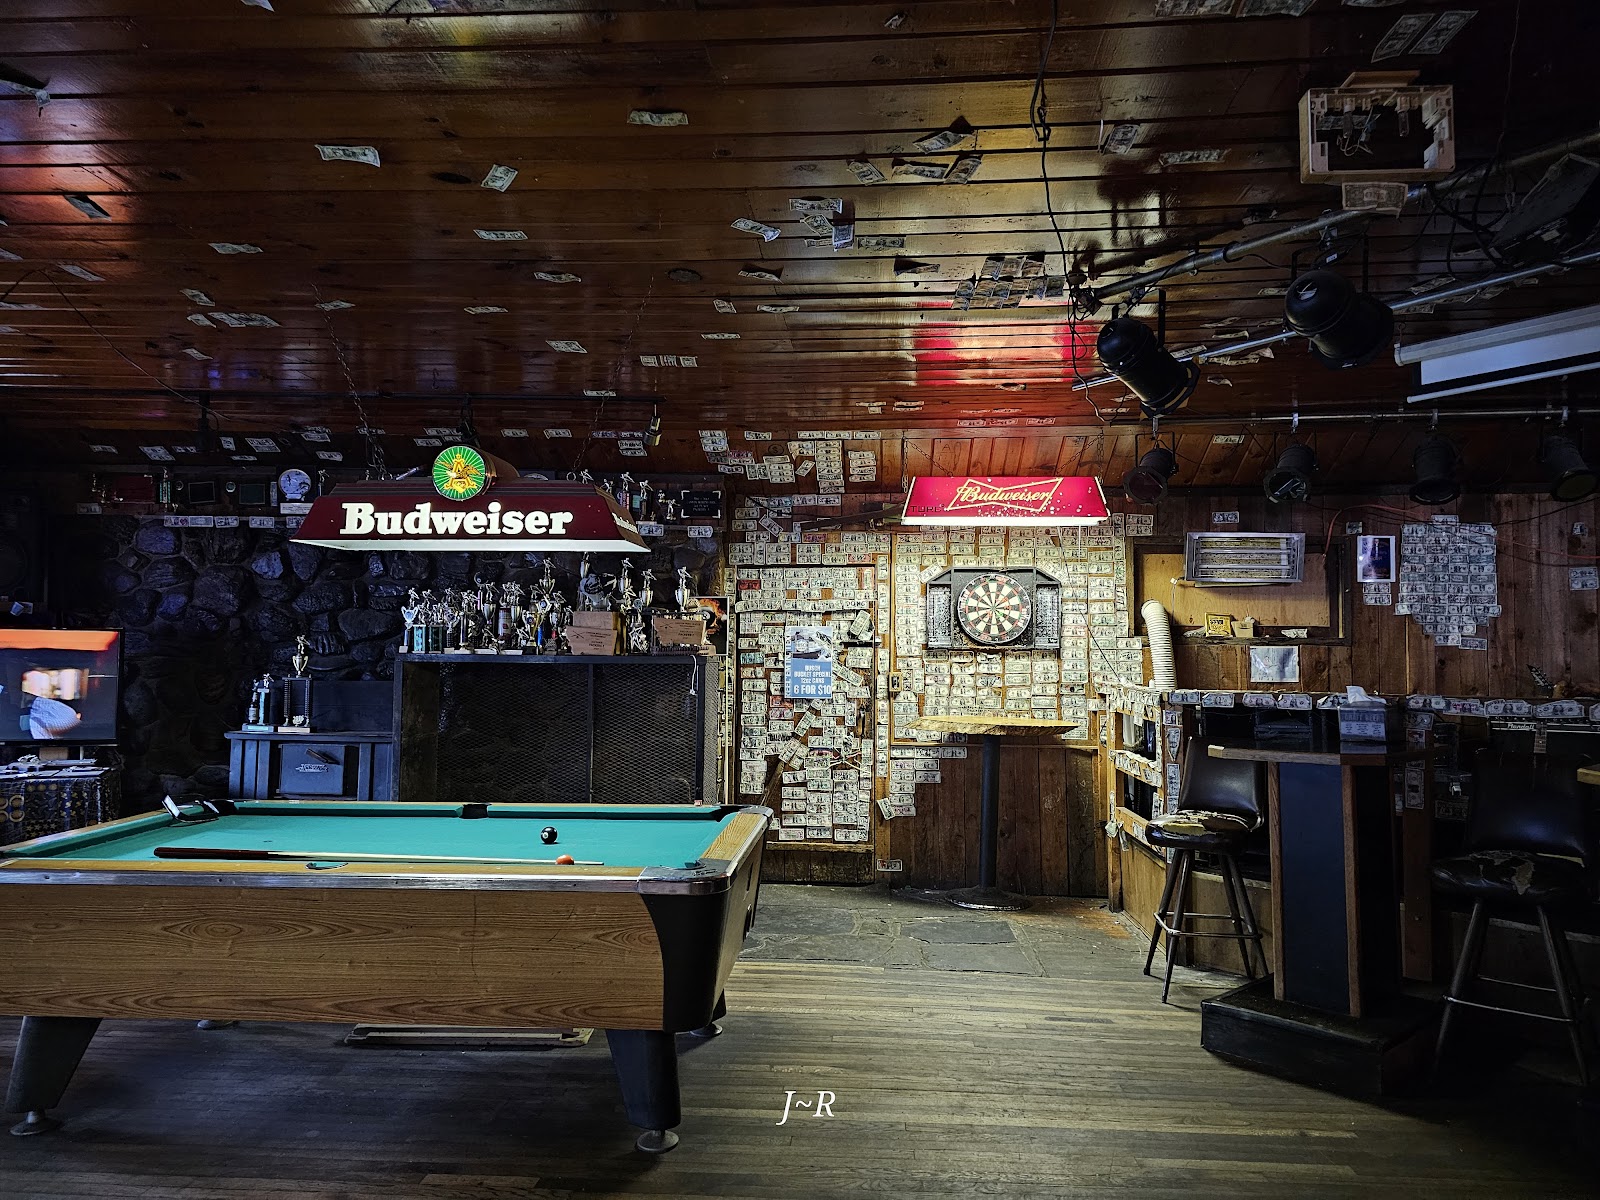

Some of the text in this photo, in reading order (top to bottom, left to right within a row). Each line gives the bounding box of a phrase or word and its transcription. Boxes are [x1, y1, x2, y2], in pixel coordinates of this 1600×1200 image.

[957, 486, 1053, 503] Budweiser
[340, 502, 573, 536] Budweiser
[794, 685, 831, 695] 6 FOR $10
